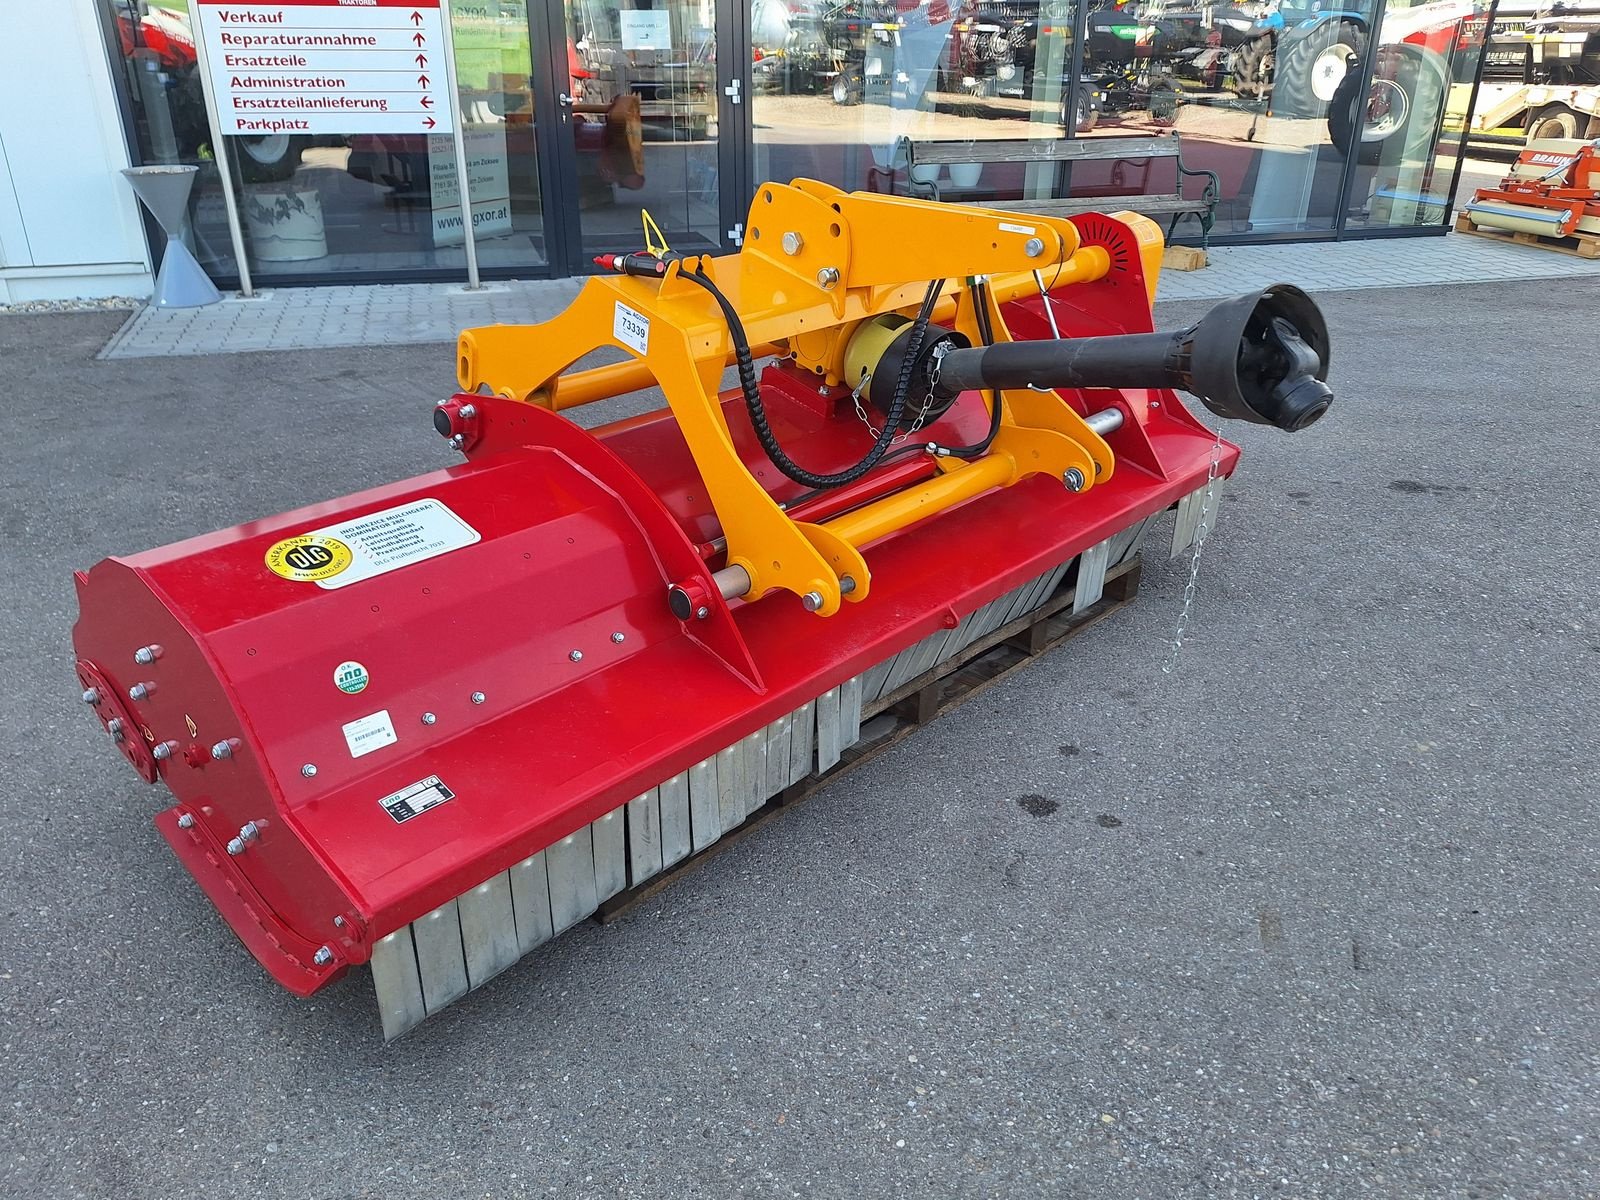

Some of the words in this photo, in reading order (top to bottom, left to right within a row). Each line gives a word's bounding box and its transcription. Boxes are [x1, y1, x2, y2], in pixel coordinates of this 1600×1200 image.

[218, 11, 283, 24] Verkauf
[221, 32, 377, 47] Reparaturannahme
[225, 54, 307, 67] Ersatzteile
[230, 76, 346, 89] Administration
[233, 97, 388, 111] Ersatzteilanlieferung
[236, 118, 310, 133] Parkplatz
[437, 206, 508, 229] wwwgxor.at
[622, 316, 646, 339] 73339
[344, 522, 391, 539] DOMINATOR
[366, 525, 425, 547] Leistungsbedarf
[370, 534, 420, 552] Handhabung
[376, 539, 425, 557] Praxiseinsatz
[271, 537, 314, 567] ANERKANNT
[318, 538, 341, 550] 2019
[289, 546, 330, 568] DLG
